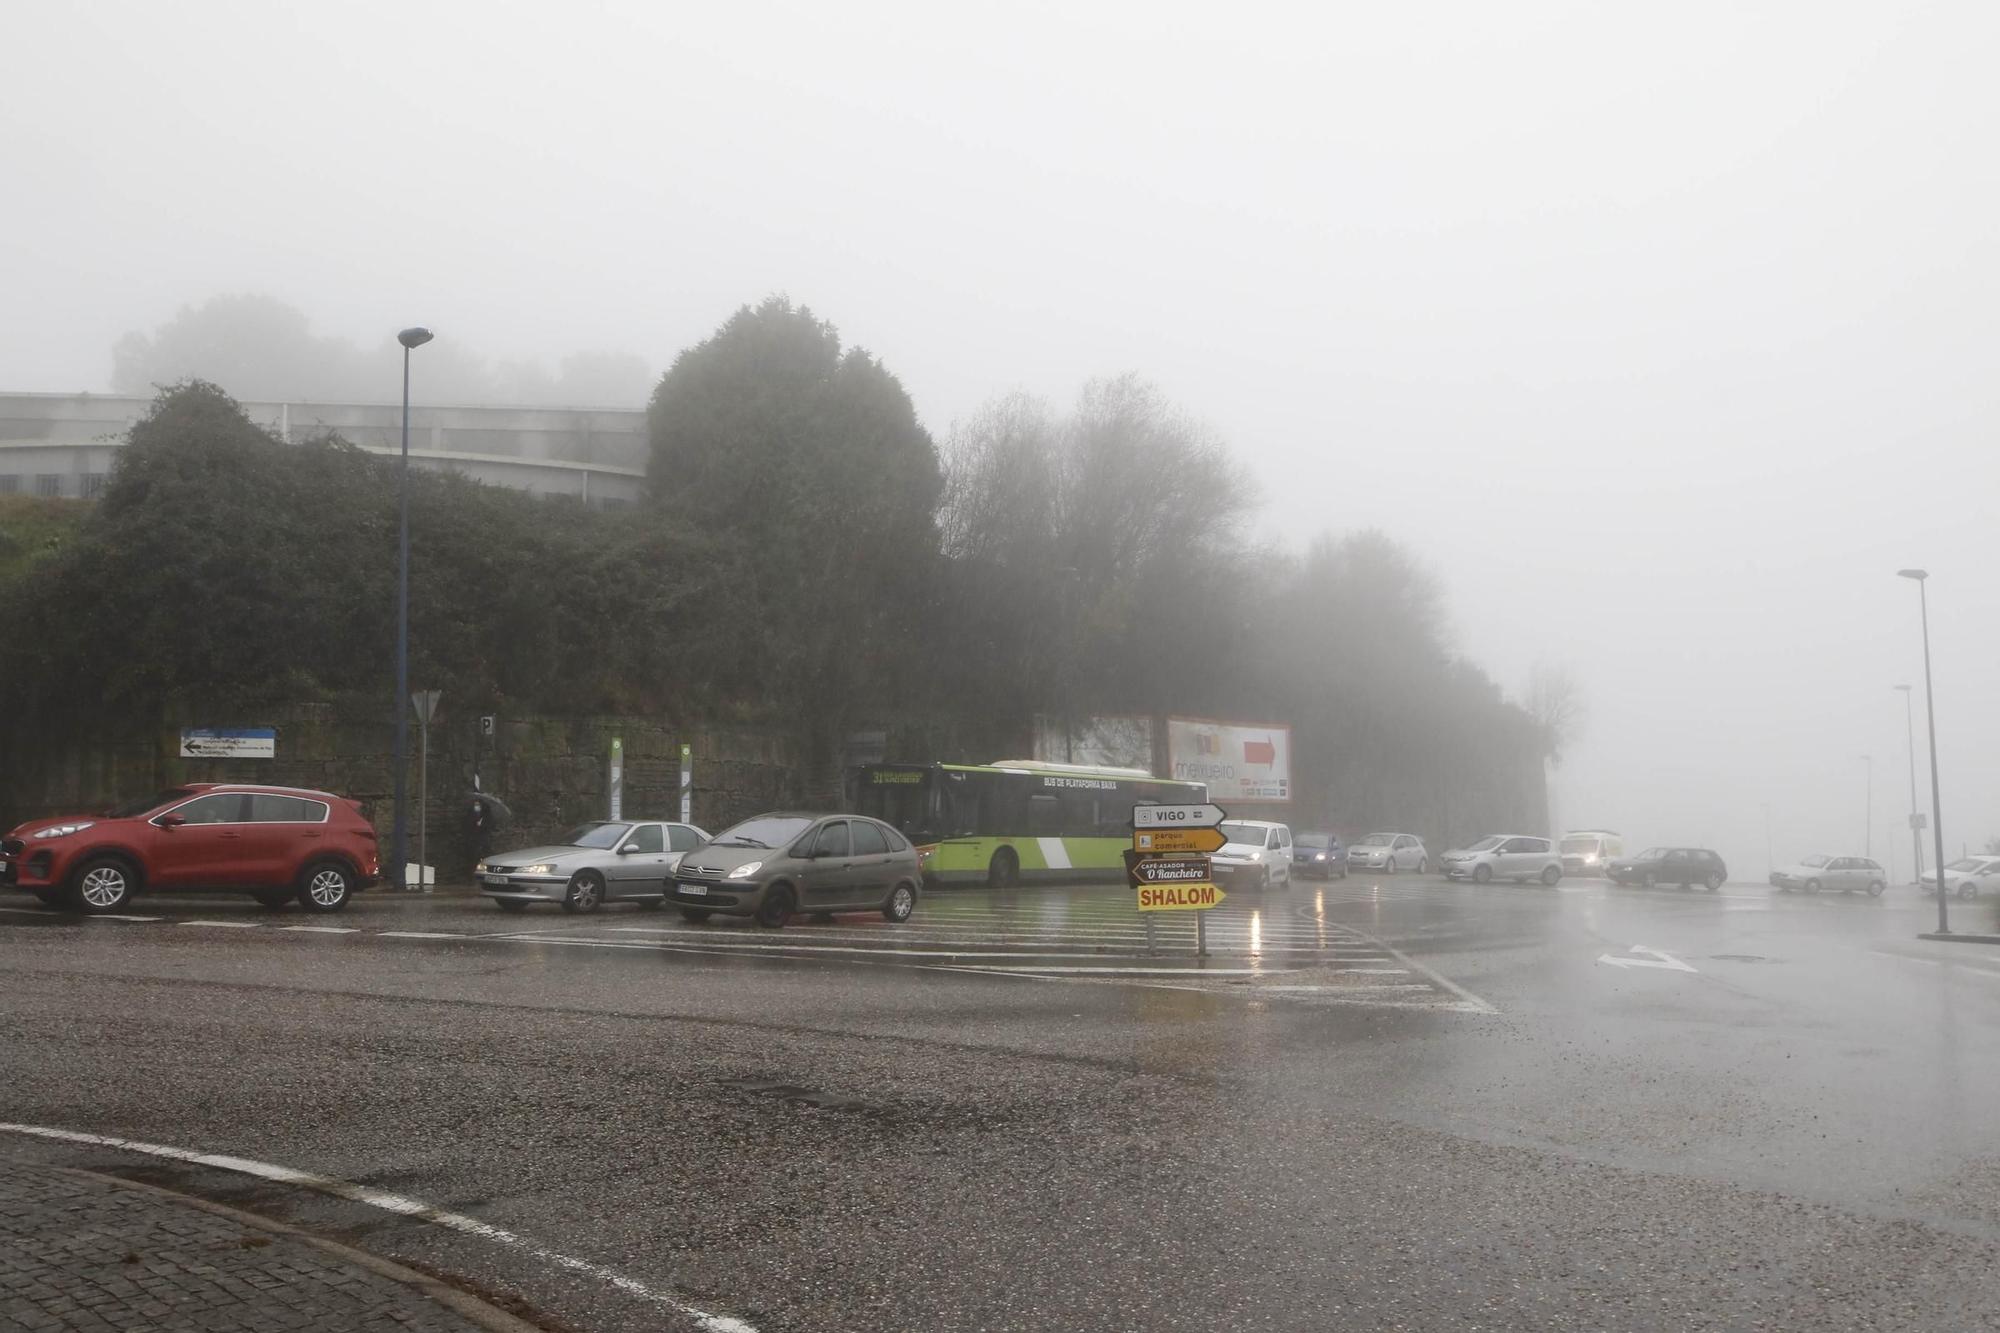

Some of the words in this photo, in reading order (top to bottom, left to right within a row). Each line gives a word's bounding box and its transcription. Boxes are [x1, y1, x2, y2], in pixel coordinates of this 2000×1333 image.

[1044, 777, 1056, 787] BUS
[1057, 778, 1065, 787] DE
[1066, 778, 1100, 788] PLATAFORMA
[1101, 781, 1117, 790] BAIXA
[1156, 811, 1185, 820] VIGO
[1157, 868, 1203, 879] Rancheiro
[1141, 888, 1215, 906] SHALOM
